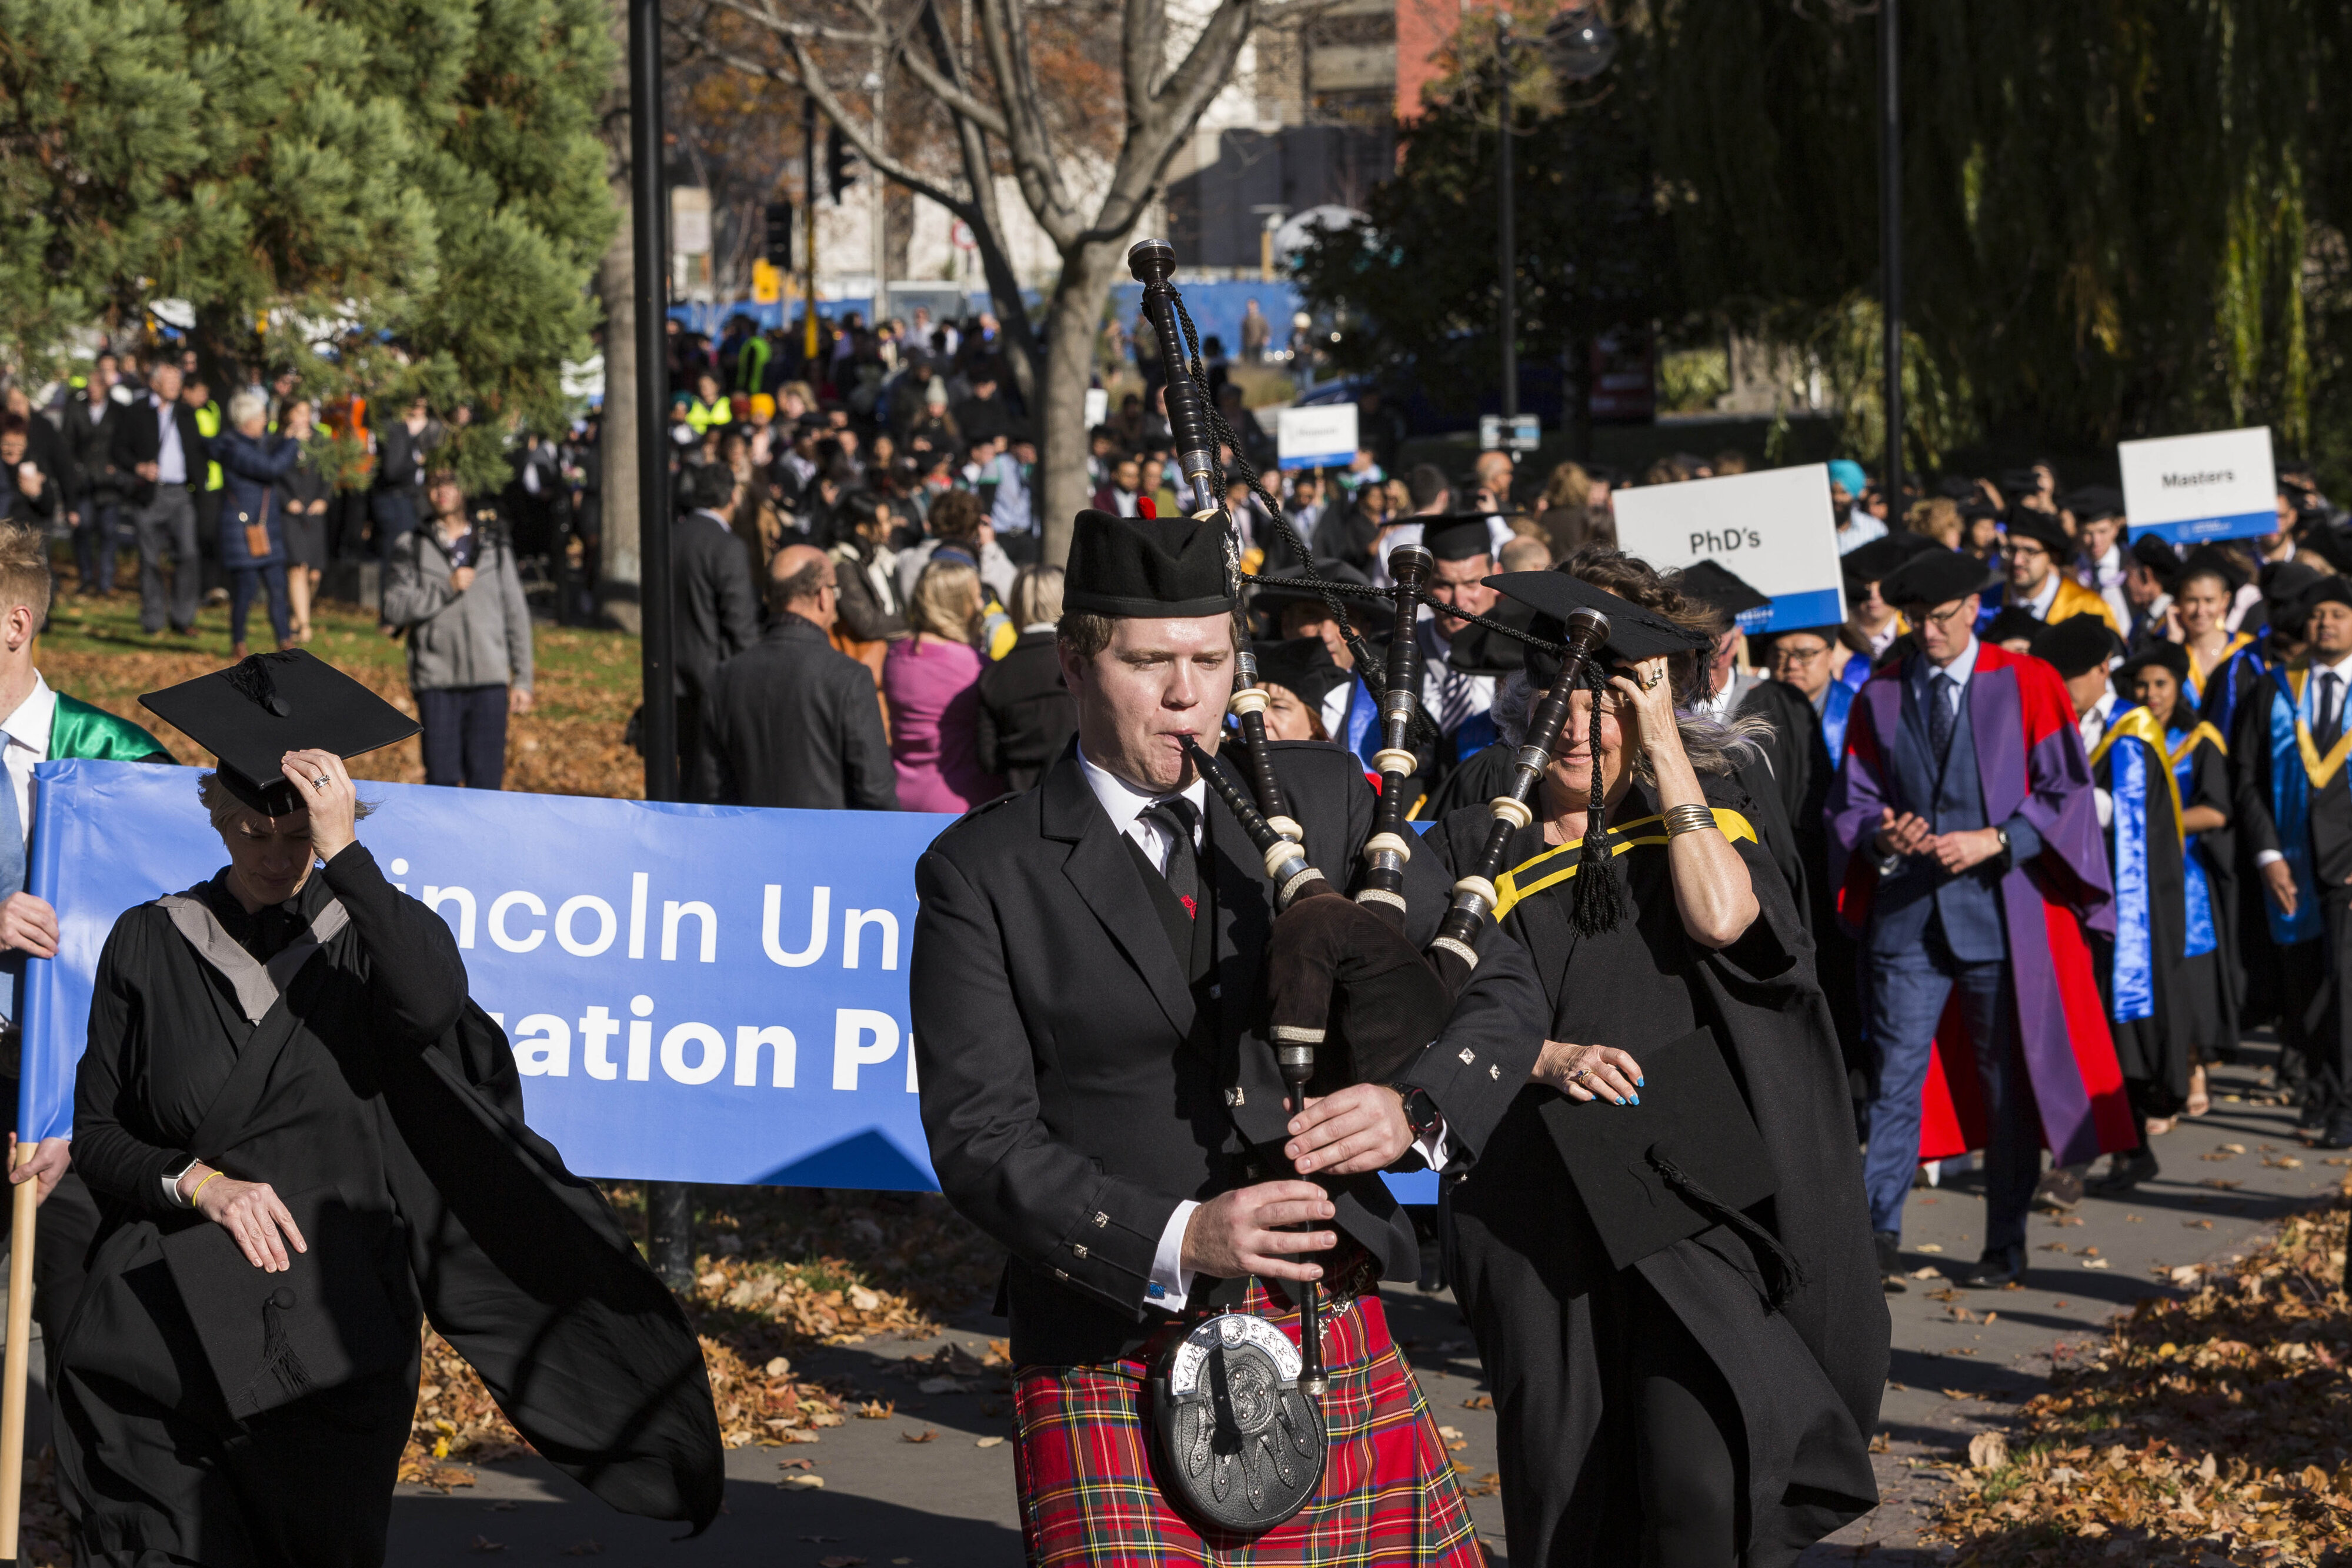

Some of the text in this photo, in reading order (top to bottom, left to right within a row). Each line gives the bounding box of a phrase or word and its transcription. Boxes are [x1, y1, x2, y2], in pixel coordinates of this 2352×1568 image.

[2161, 469, 2235, 489] Masters
[1689, 526, 1762, 555] PhD's
[391, 858, 919, 970] ncoln Un
[486, 995, 796, 1089] ation
